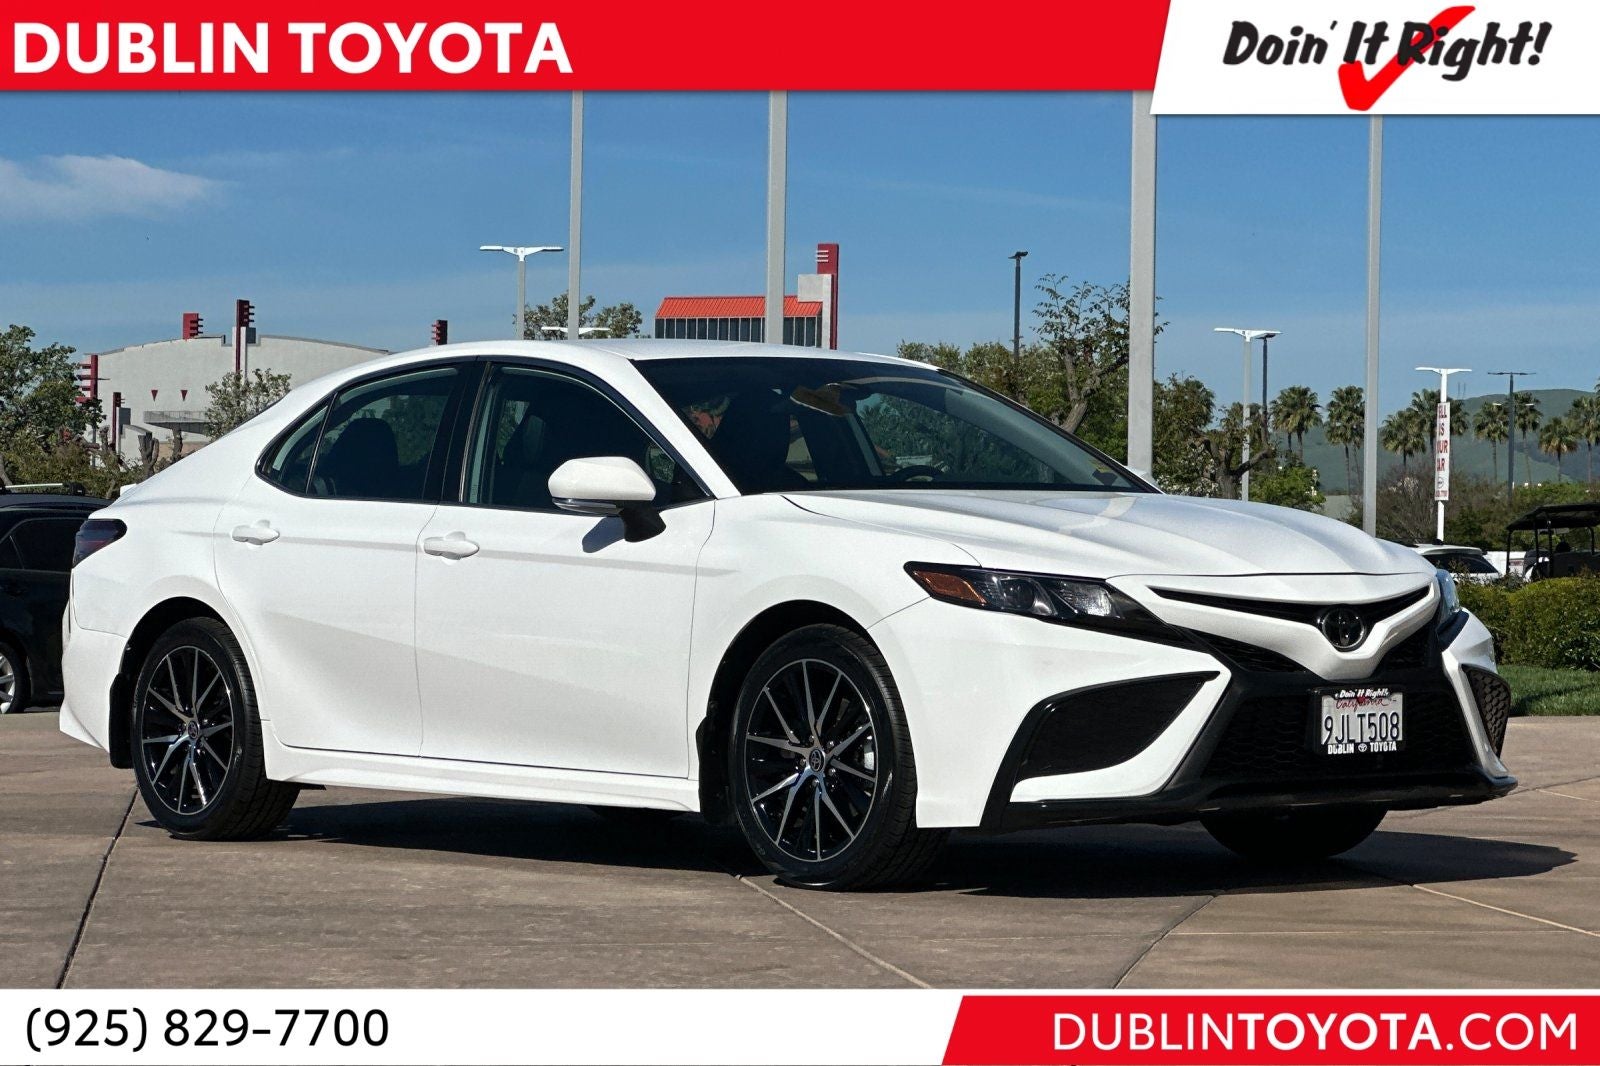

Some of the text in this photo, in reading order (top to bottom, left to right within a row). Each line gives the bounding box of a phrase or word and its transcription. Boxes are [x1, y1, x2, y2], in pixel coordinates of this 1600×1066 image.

[1336, 697, 1389, 712] Califrnia
[1323, 712, 1400, 745] 9JLT508
[1327, 741, 1397, 755] DUBLIN TOYOTA
